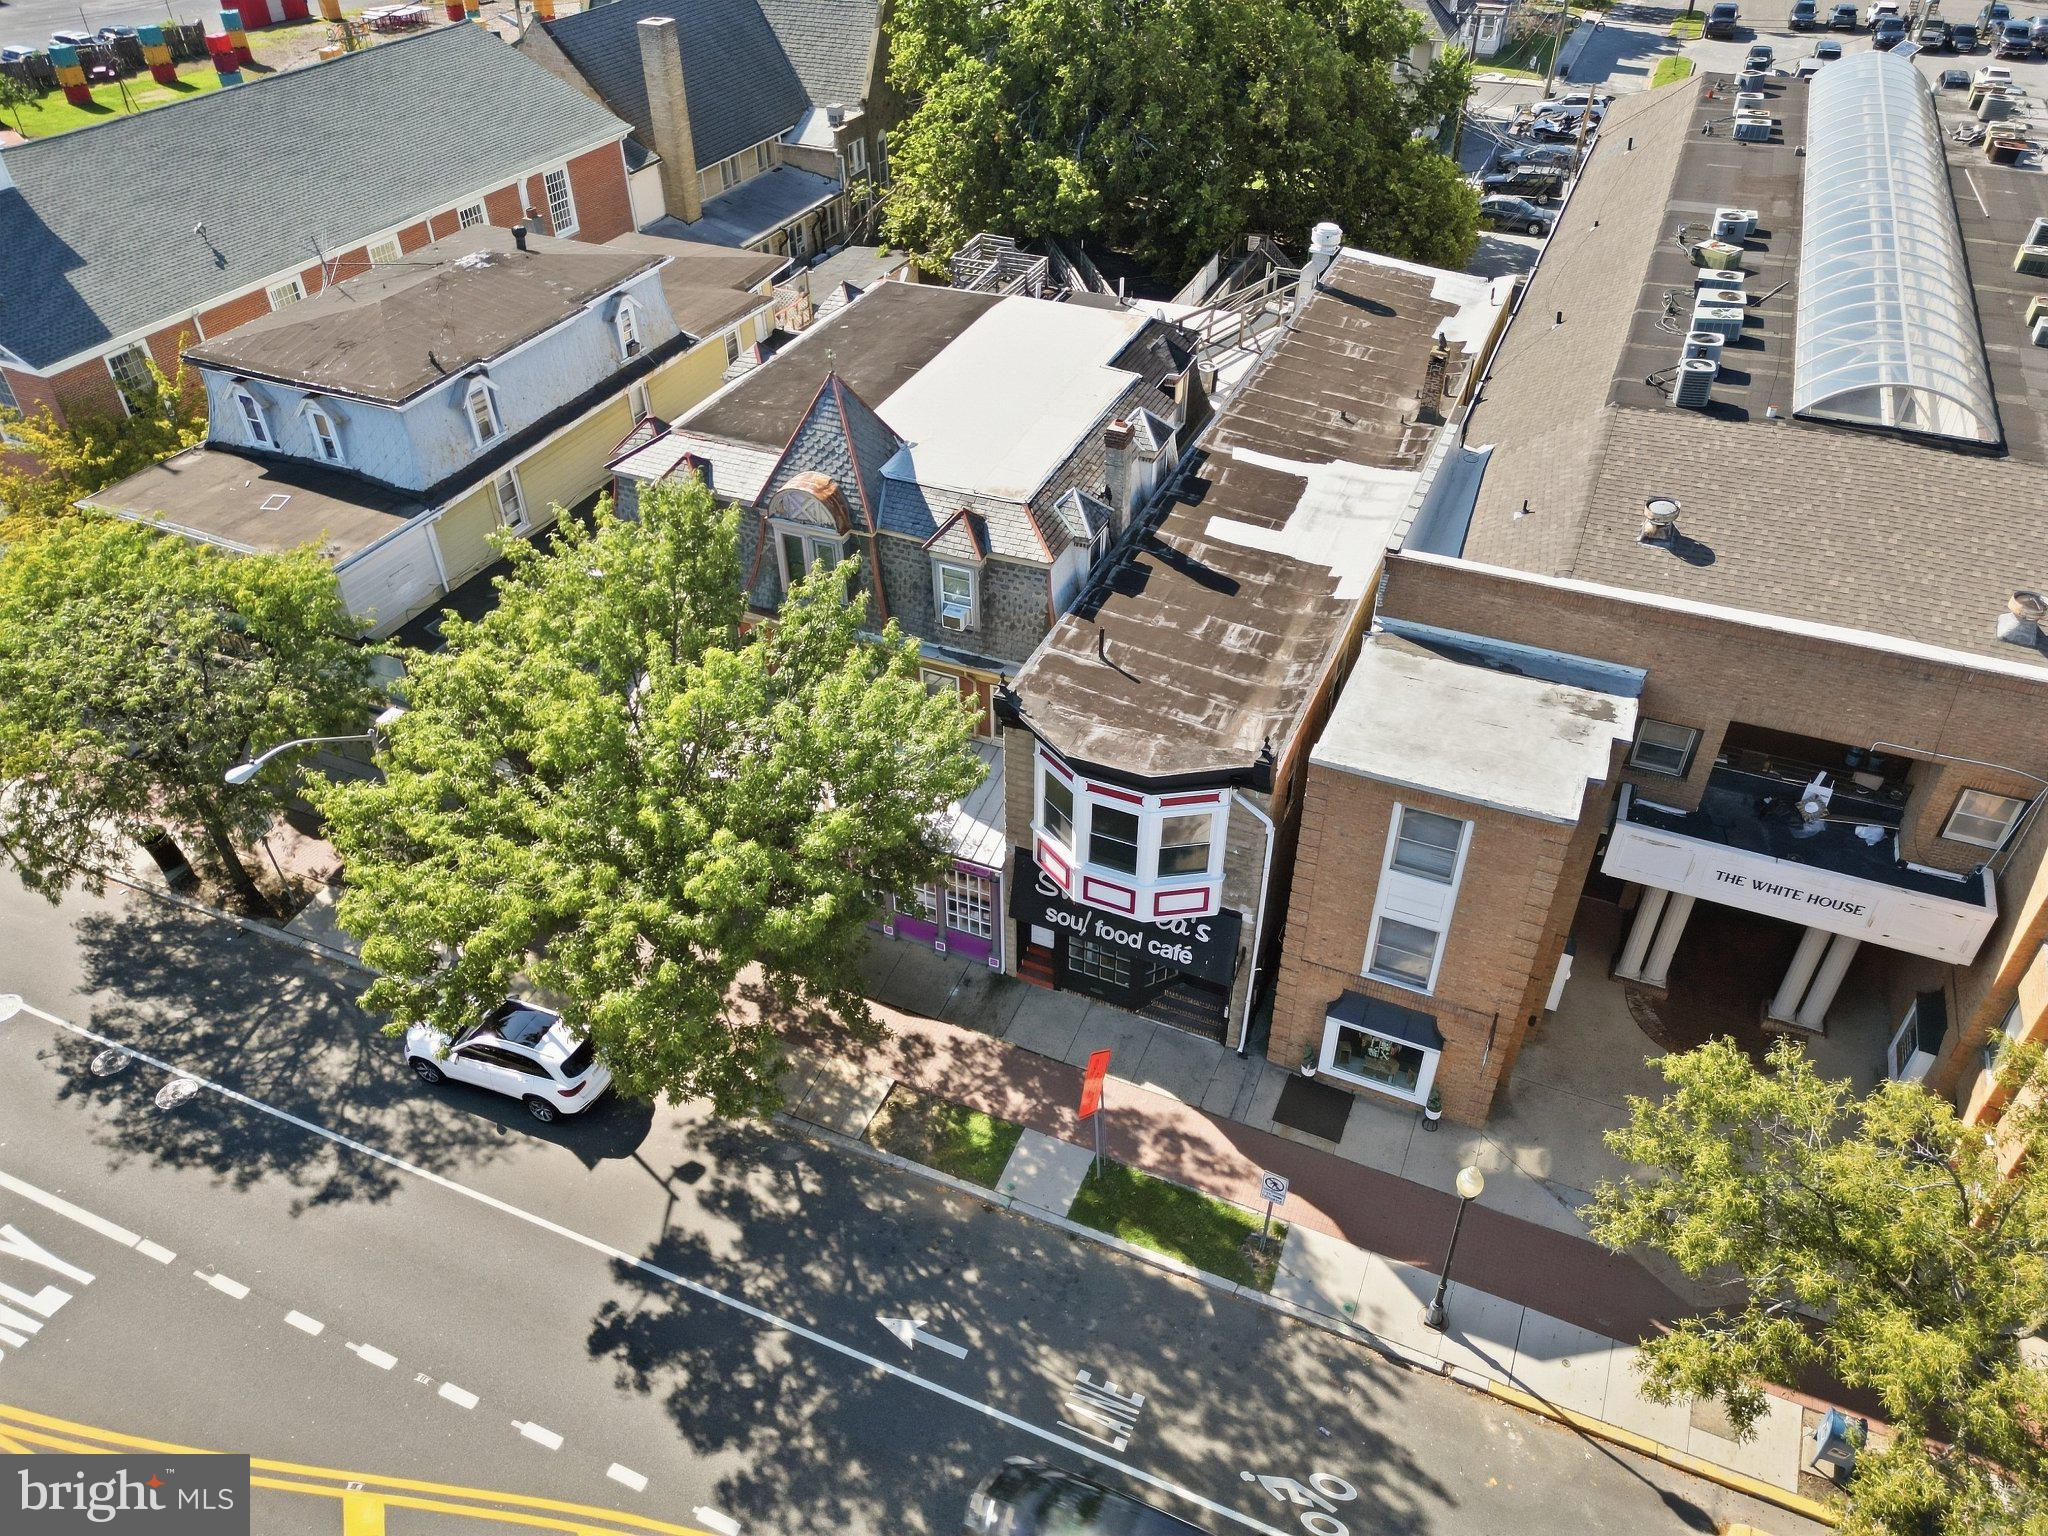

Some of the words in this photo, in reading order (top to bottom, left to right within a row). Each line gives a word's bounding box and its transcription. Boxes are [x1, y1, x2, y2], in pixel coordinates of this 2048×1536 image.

[1716, 870, 1747, 886] THE
[1752, 879, 1804, 900] WHITE
[1807, 893, 1866, 916] HOUSE
[1045, 907, 1092, 936] soul
[1095, 920, 1143, 949] food
[1148, 940, 1193, 965] café
[1056, 1369, 1145, 1453] LANE
